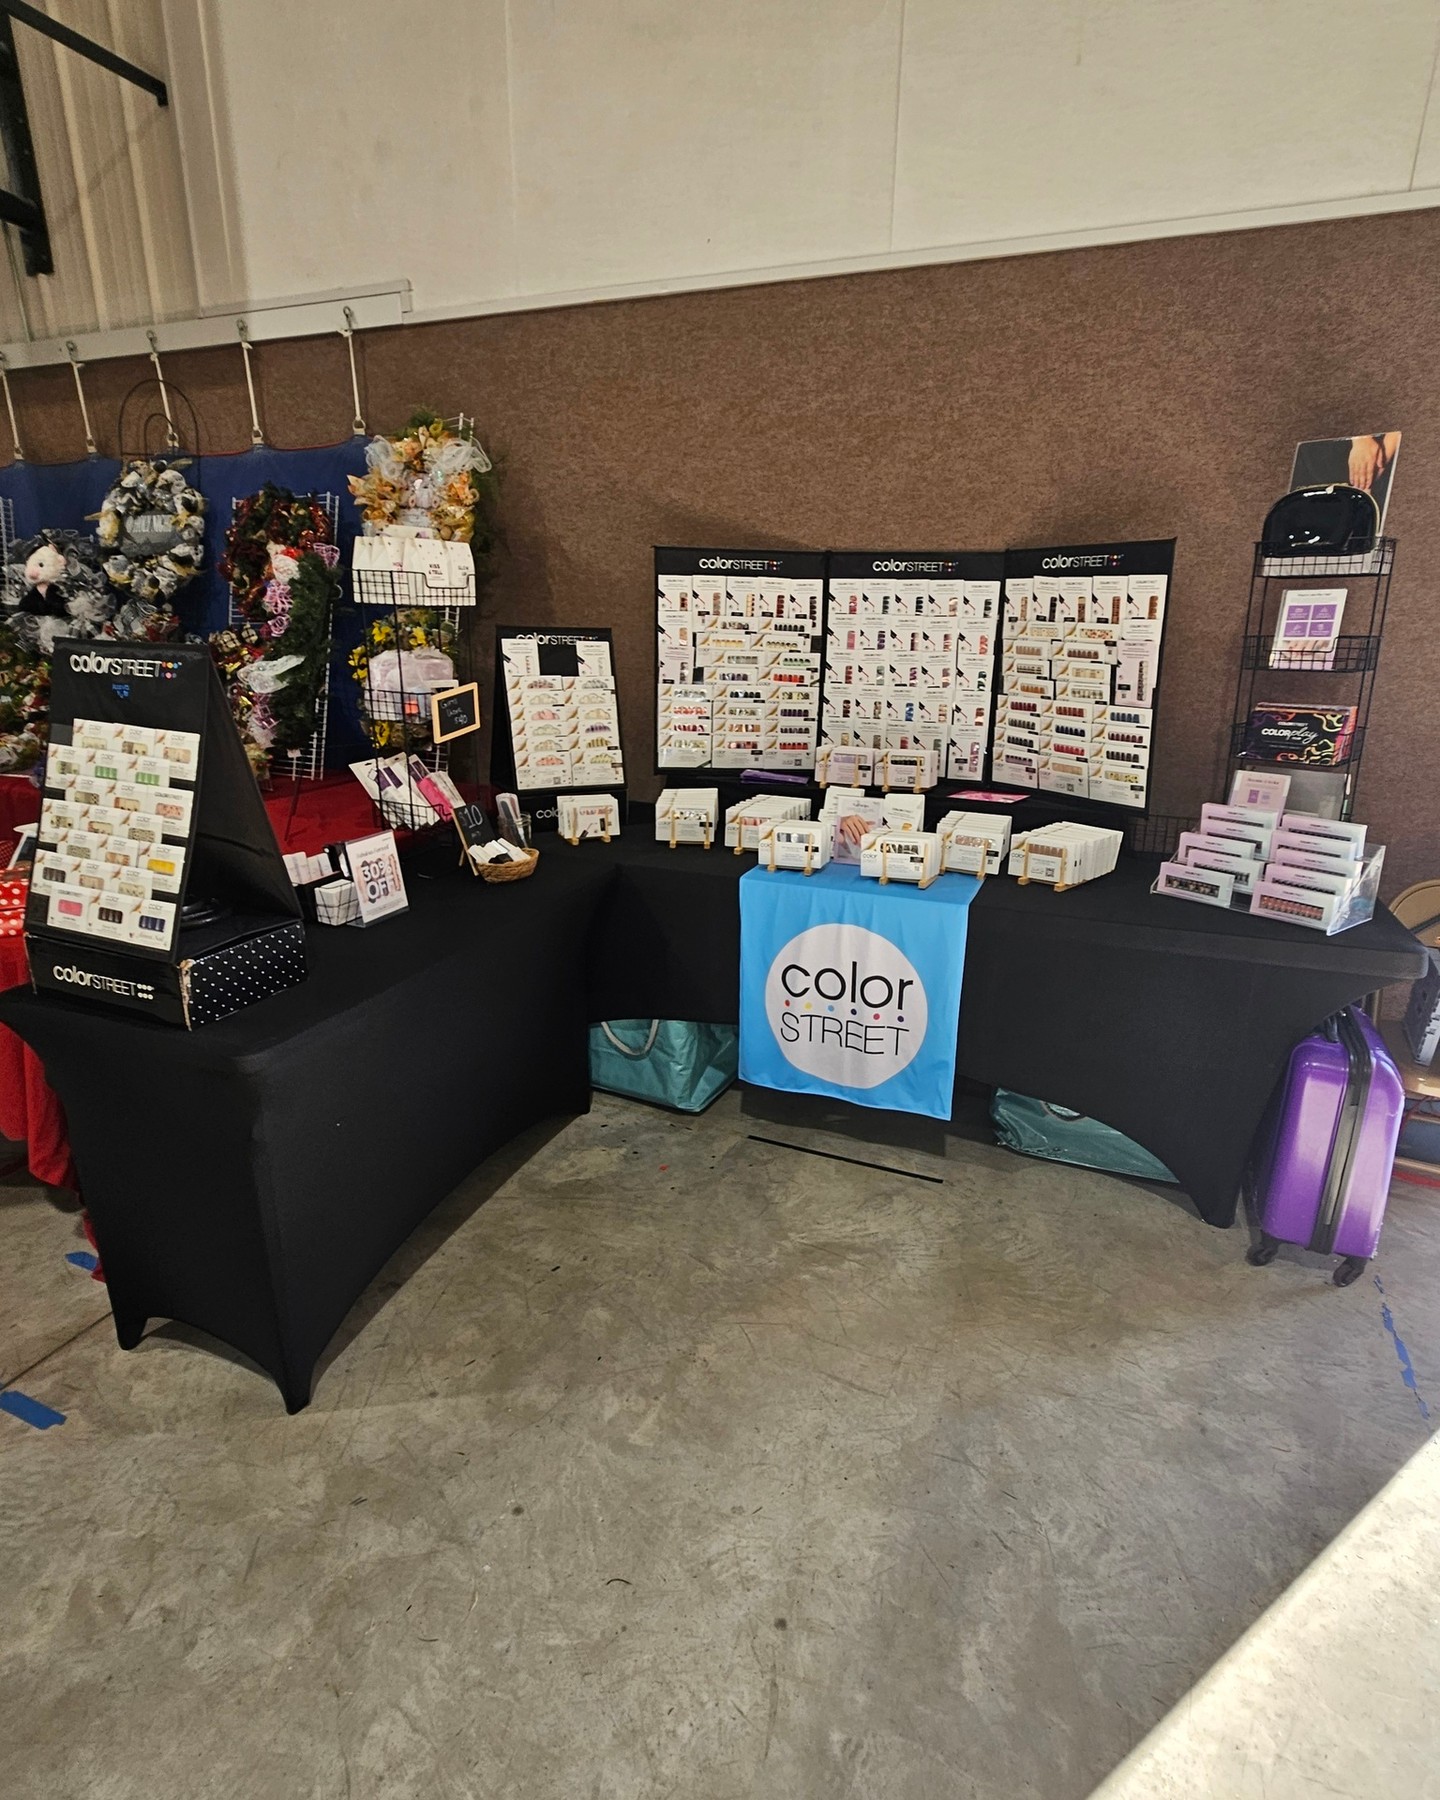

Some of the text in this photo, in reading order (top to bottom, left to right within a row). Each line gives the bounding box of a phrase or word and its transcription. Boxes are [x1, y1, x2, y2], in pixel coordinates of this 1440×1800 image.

[361, 860, 392, 882] 30%
[367, 875, 394, 899] OFF
[781, 961, 914, 1010] color
[780, 1011, 910, 1056] STREET
